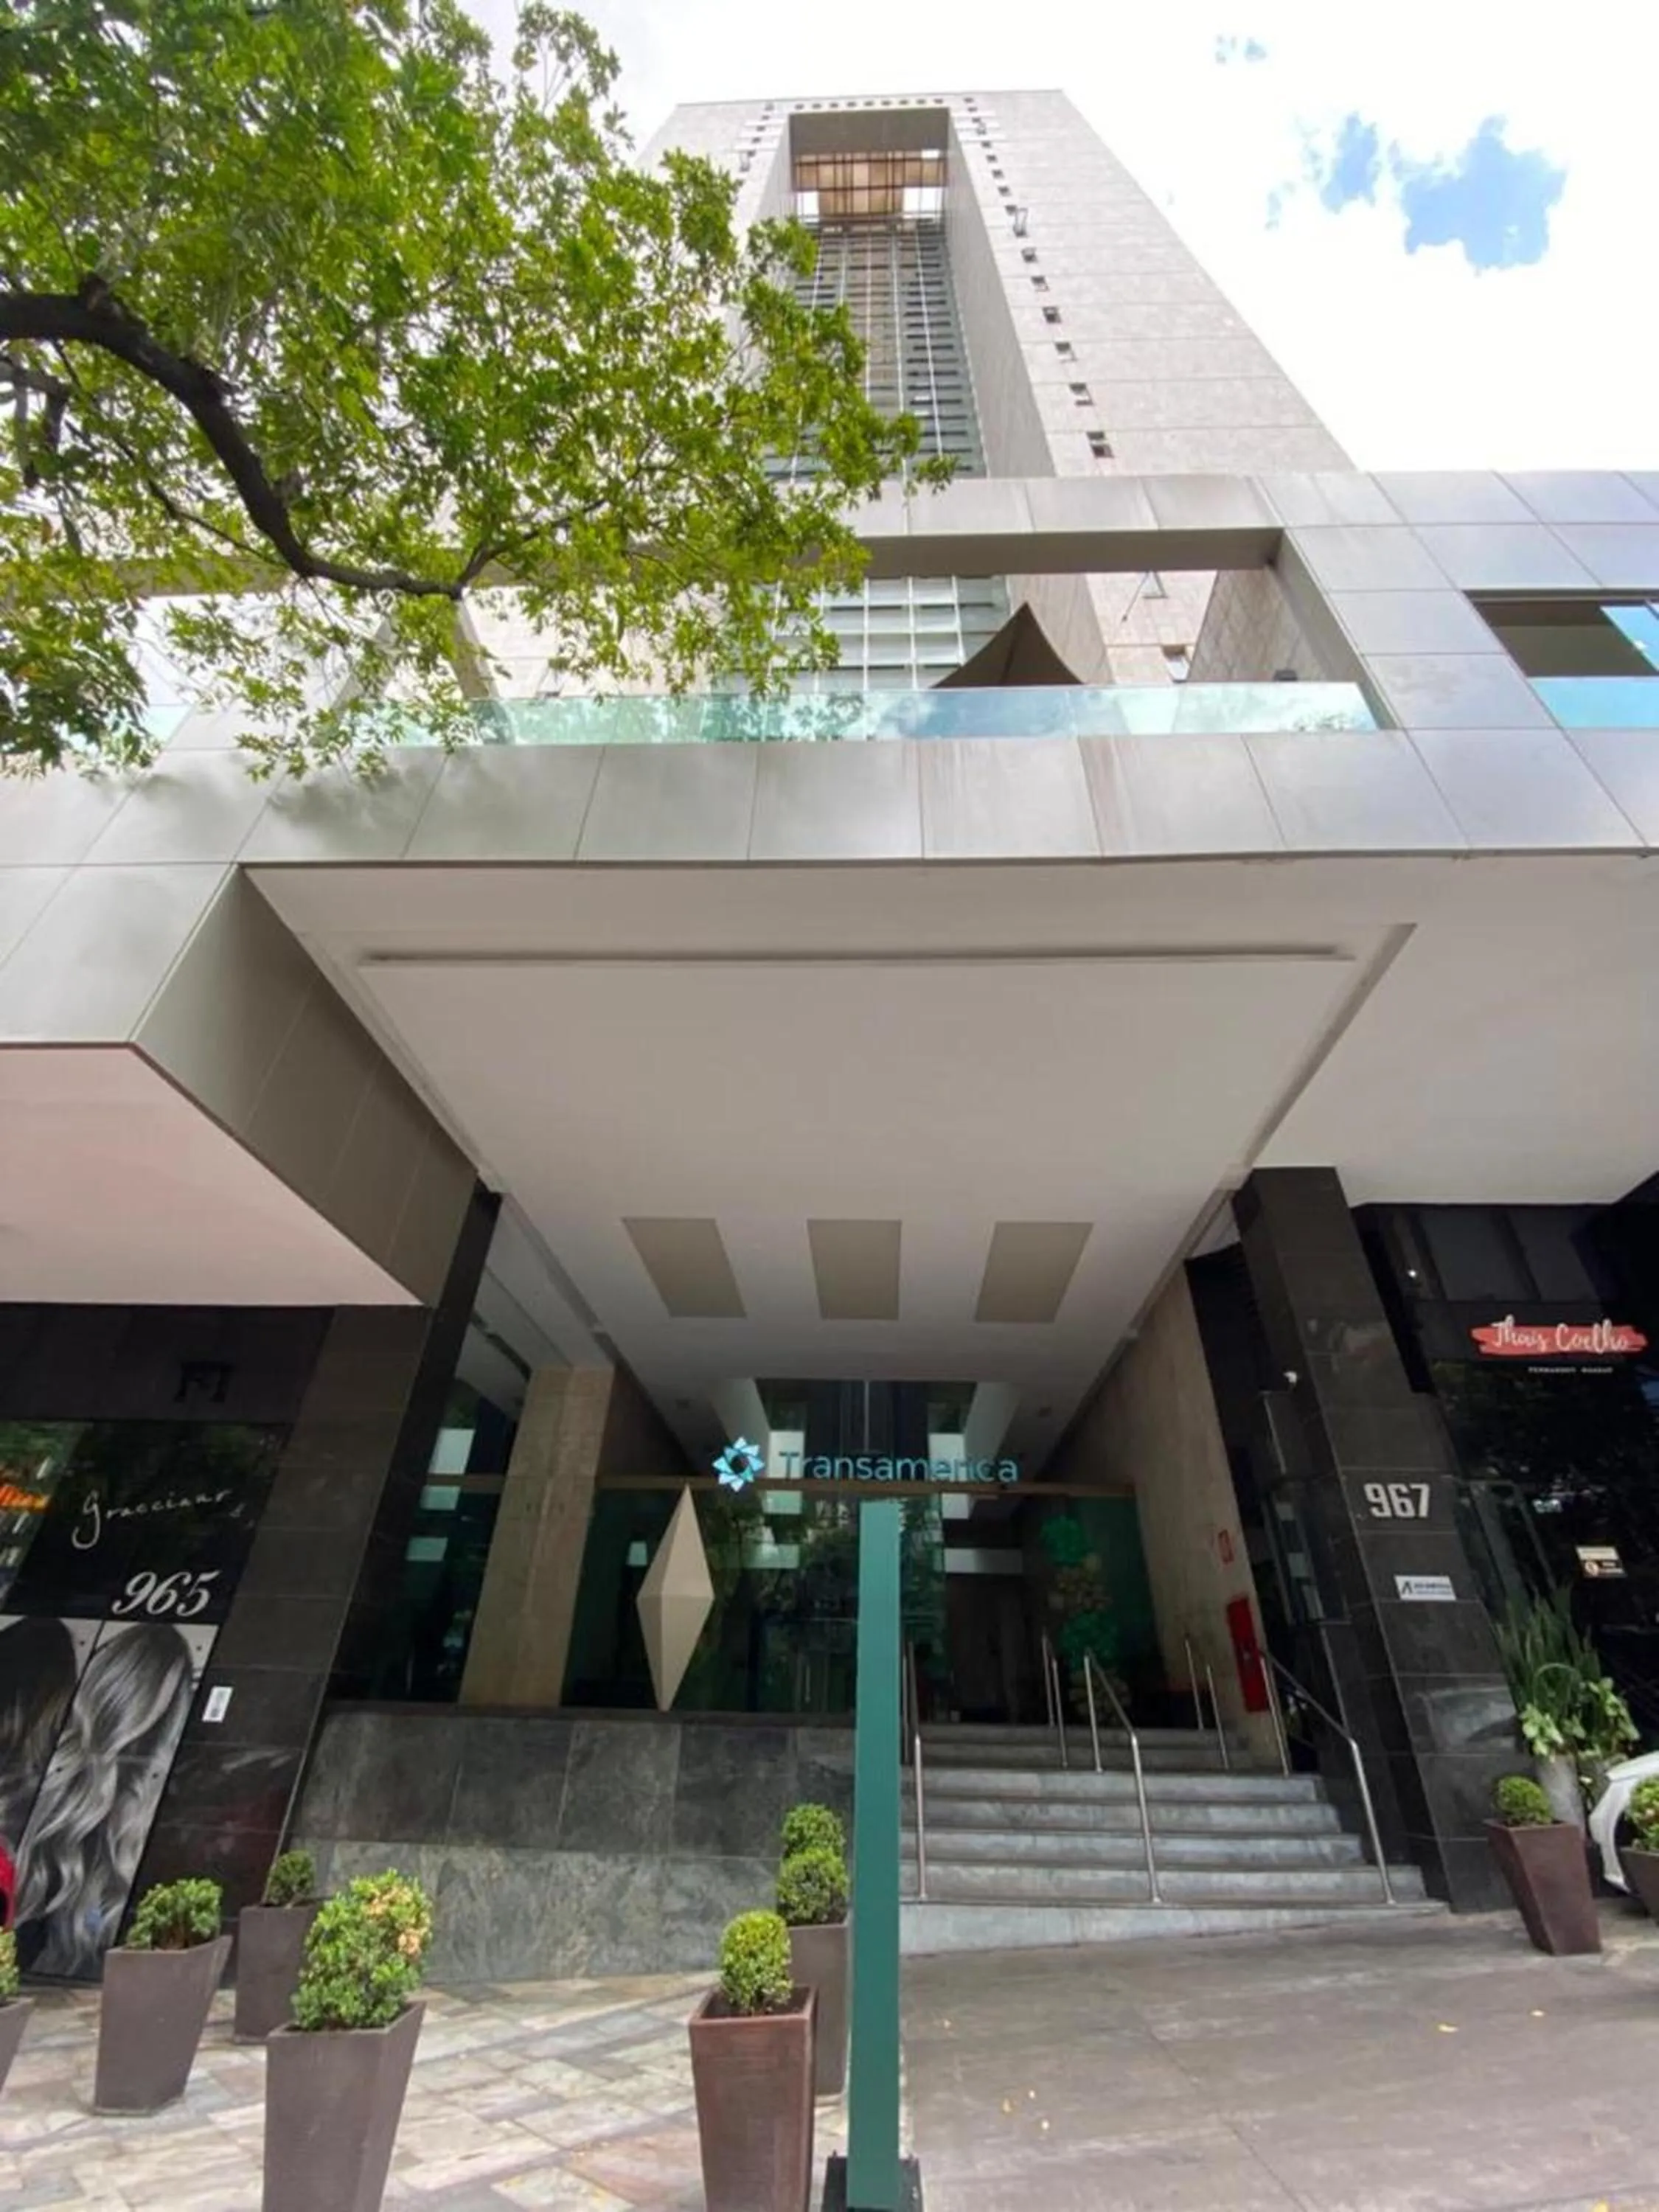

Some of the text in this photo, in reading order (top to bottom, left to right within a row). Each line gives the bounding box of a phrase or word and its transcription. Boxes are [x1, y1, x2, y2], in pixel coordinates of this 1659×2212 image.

[1556, 1319, 1630, 1354] Coelho
[779, 1450, 1018, 1482] Transamerica
[1364, 1484, 1430, 1517] 967
[111, 1571, 221, 1616] 965
